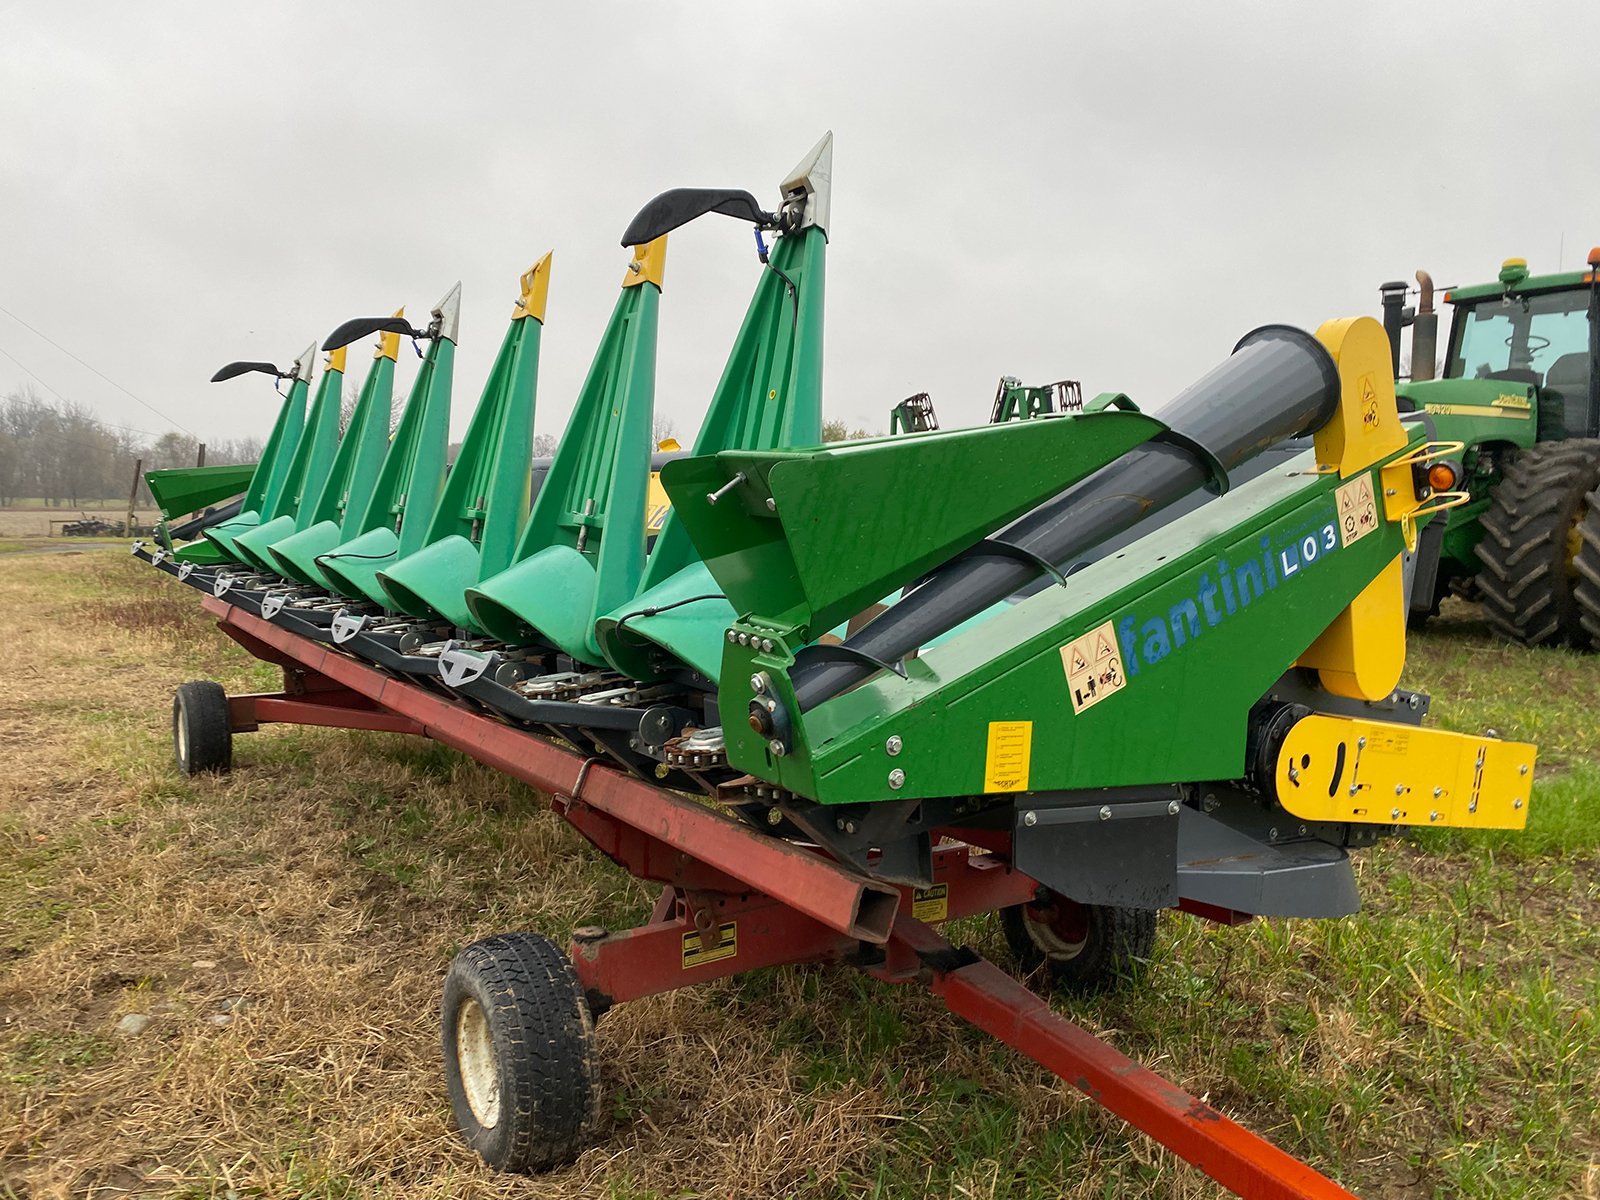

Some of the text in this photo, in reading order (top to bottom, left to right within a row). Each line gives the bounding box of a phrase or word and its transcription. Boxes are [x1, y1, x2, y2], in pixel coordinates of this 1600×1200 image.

[1345, 530, 1357, 543] STOP
[1119, 535, 1278, 677] fantini
[923, 887, 946, 898] CAUTION
